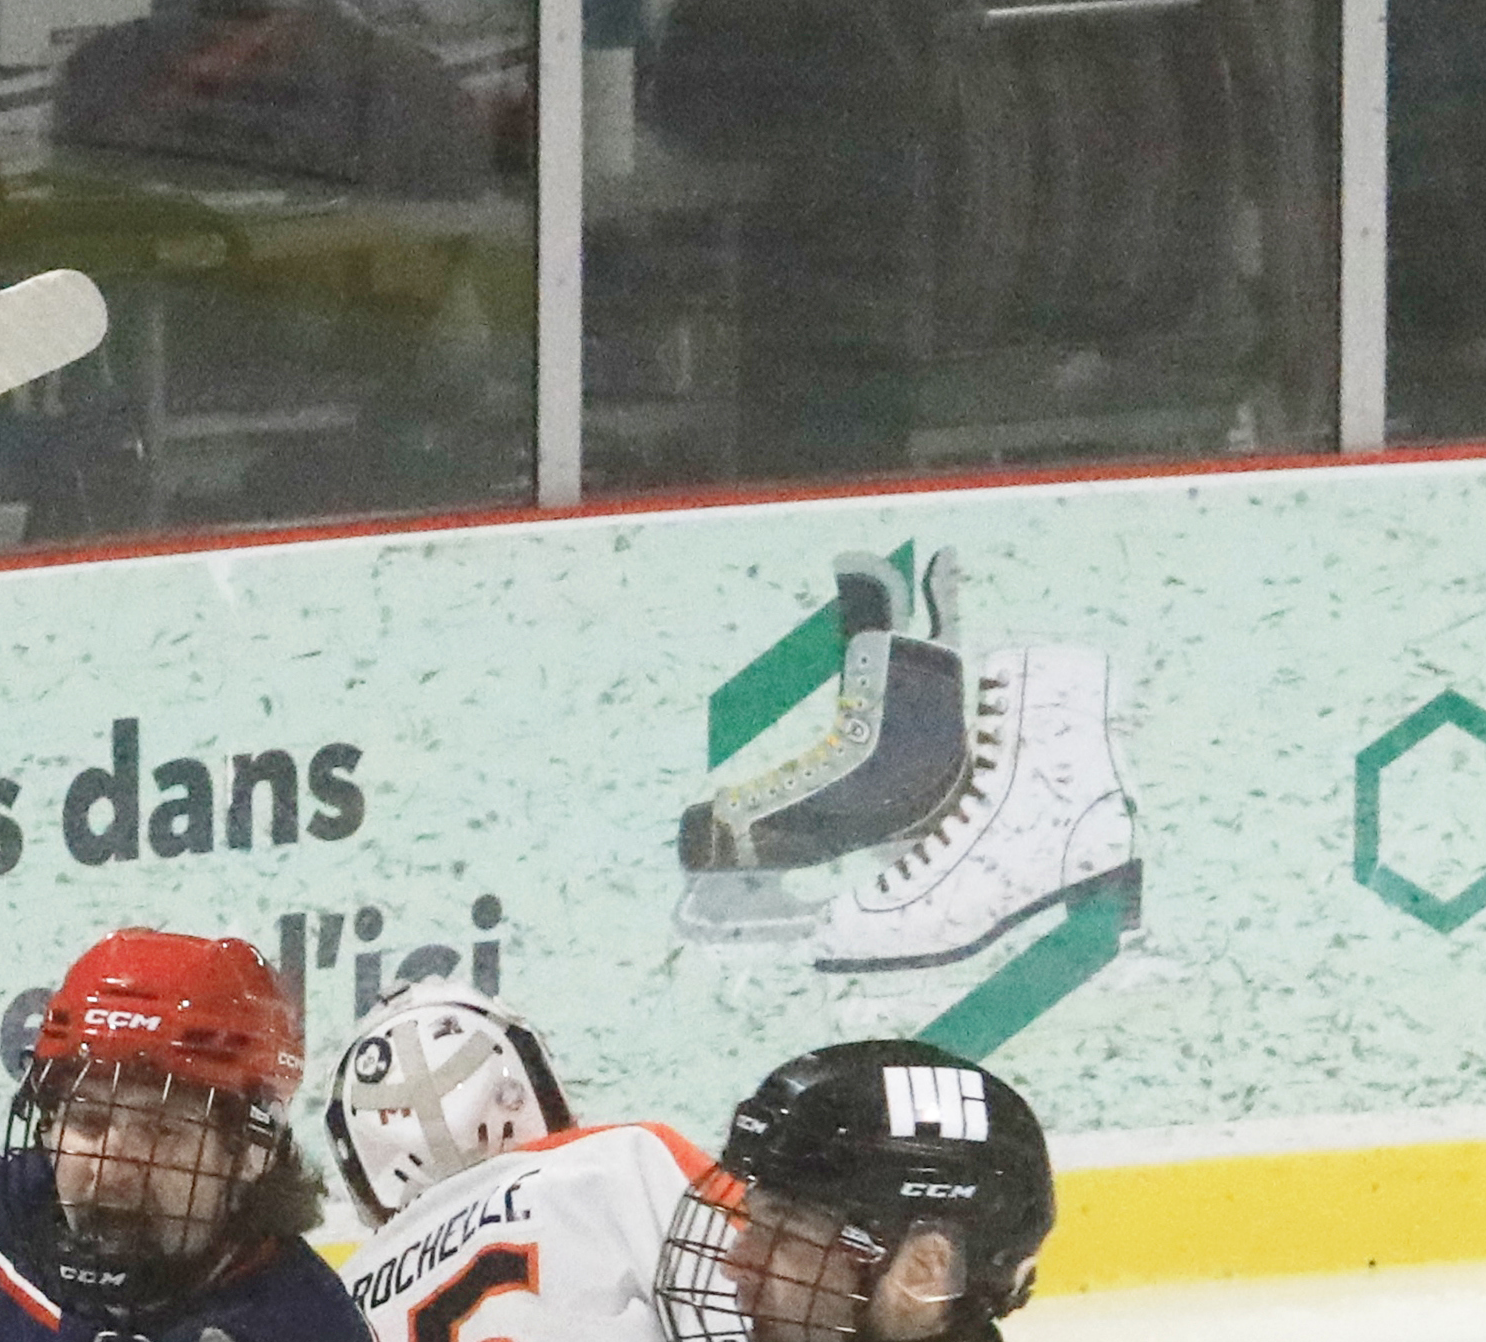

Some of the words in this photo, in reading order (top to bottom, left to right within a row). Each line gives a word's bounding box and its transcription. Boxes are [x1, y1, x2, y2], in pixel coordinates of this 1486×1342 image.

[60, 716, 365, 868] dans
[83, 1008, 162, 1032] CCM
[900, 1181, 978, 1200] CCM
